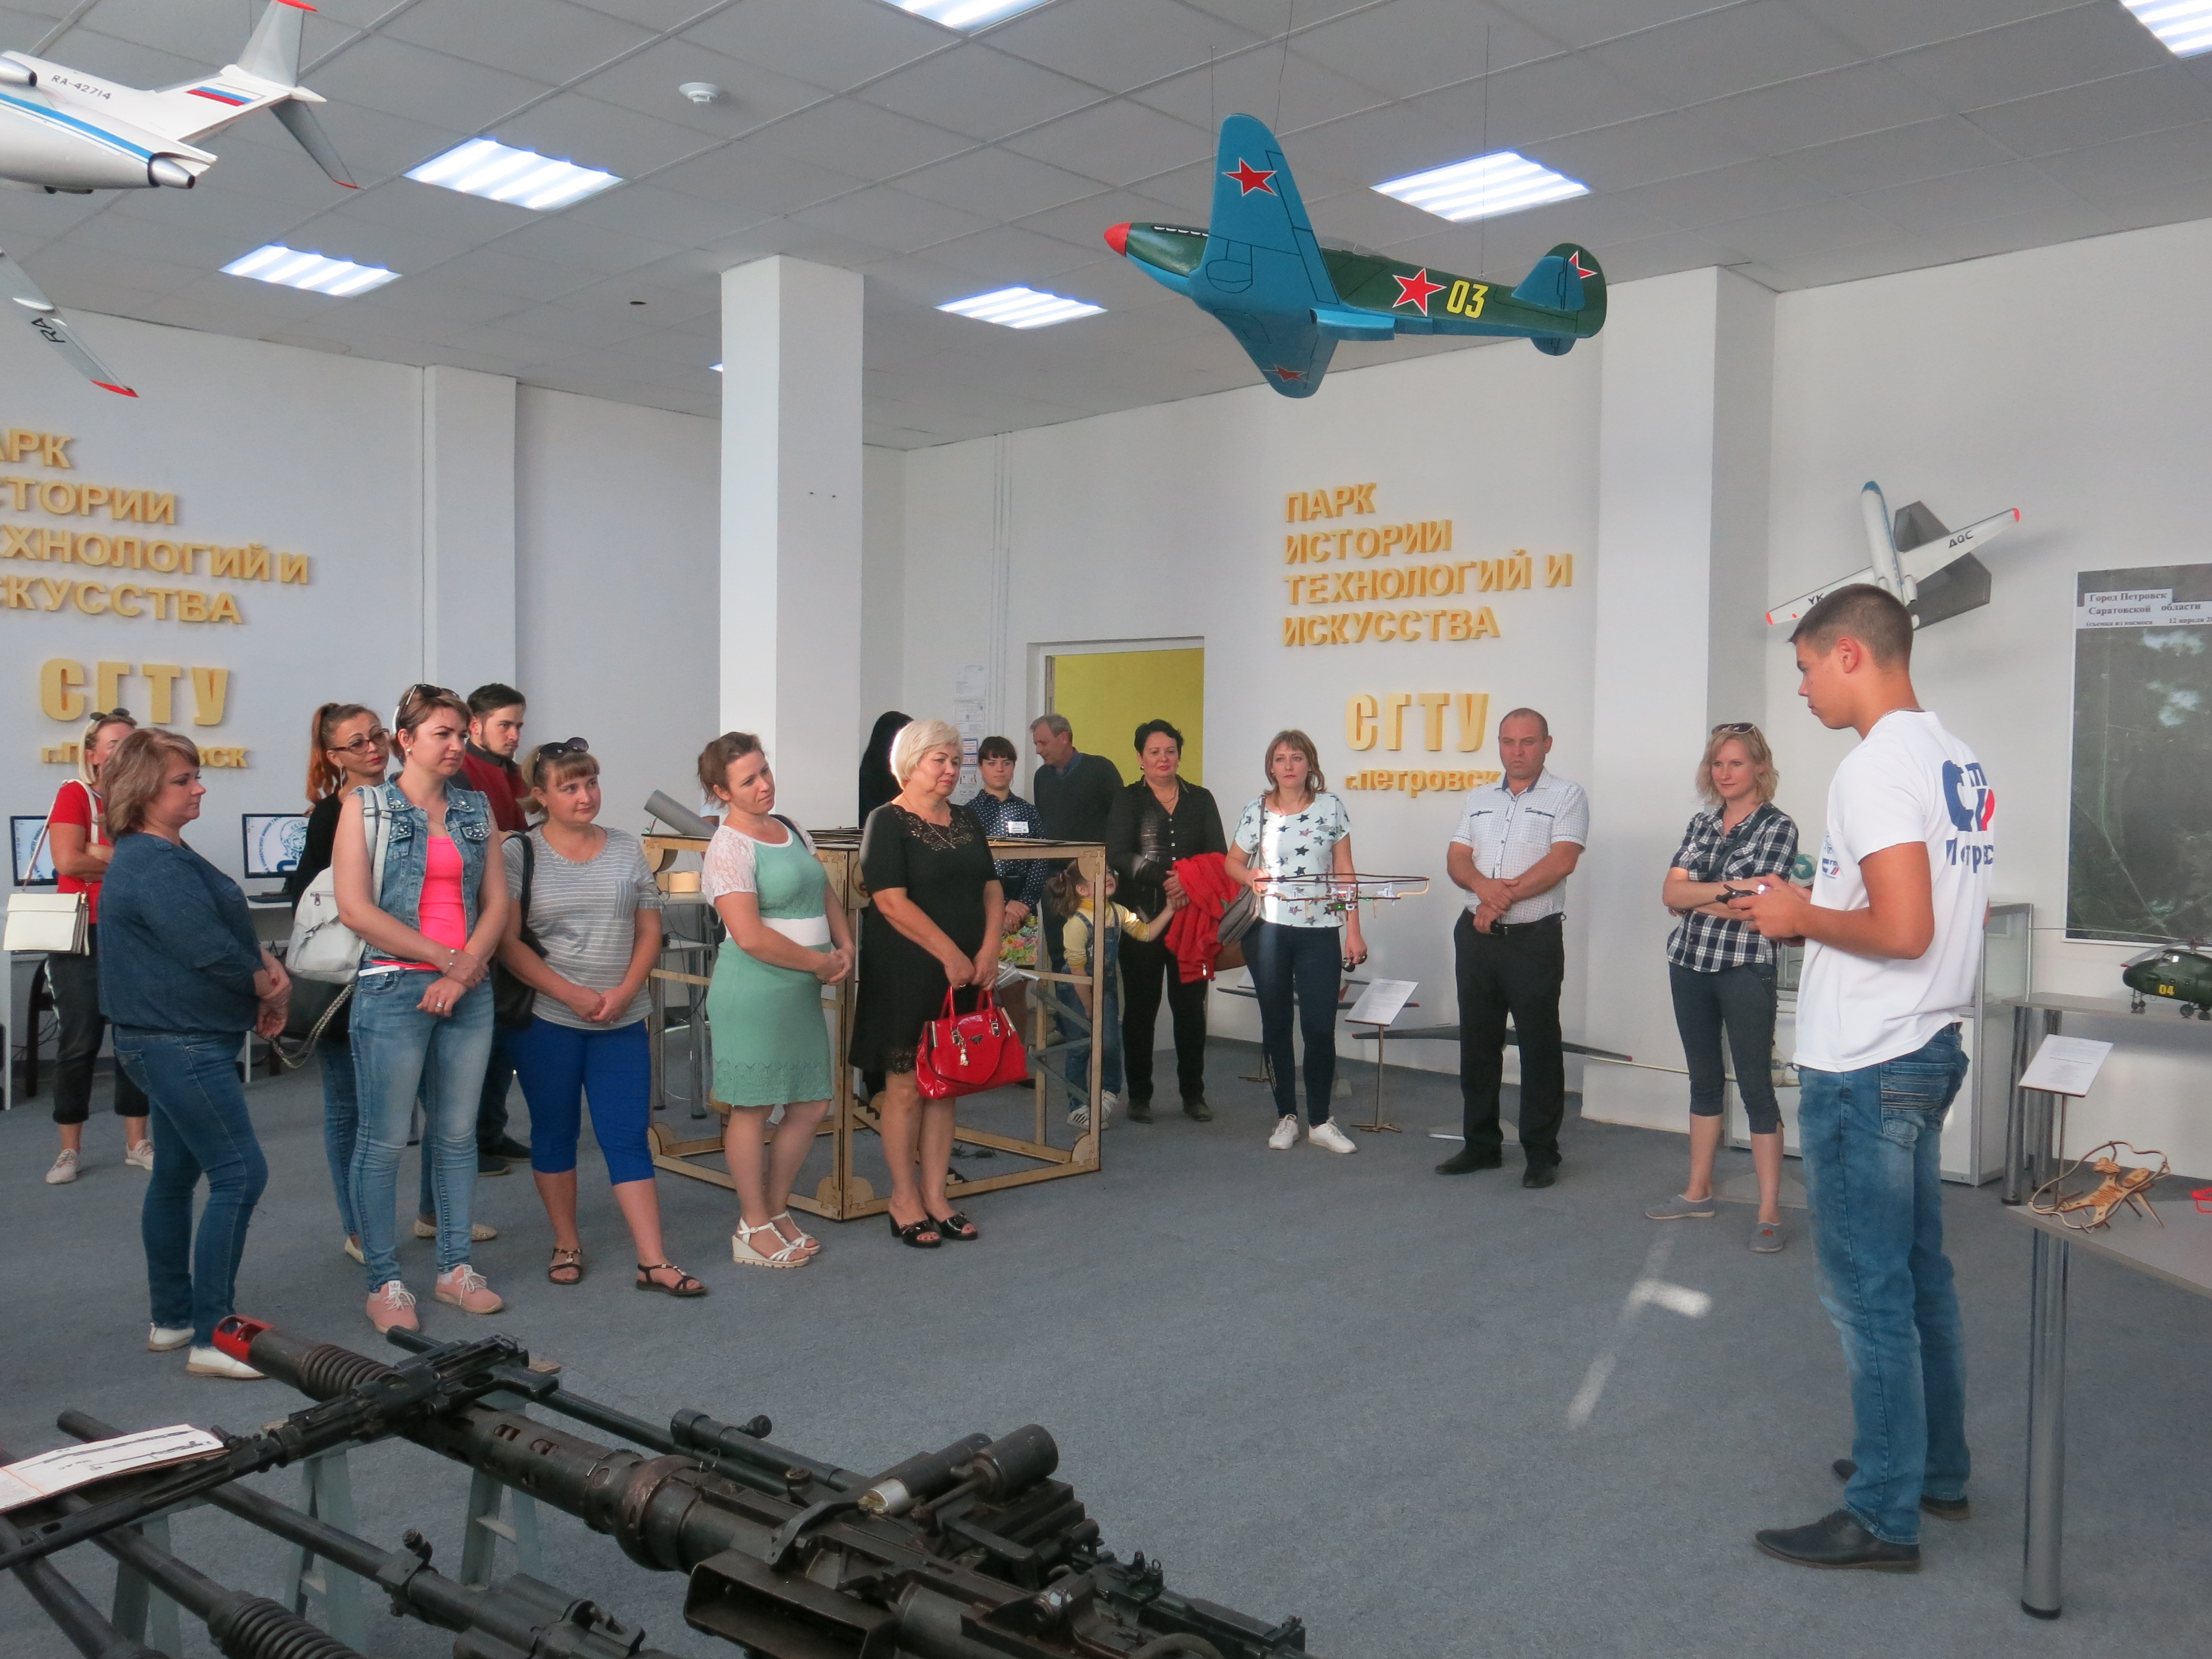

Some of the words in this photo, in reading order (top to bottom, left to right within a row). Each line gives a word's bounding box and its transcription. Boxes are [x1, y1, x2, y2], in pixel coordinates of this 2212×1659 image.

[51, 75, 112, 100] RA-42714
[1446, 280, 1489, 319] 03
[0, 429, 71, 469] РК
[0, 476, 175, 525] ТОРИИ
[1285, 482, 1377, 523] ПАРК
[0, 524, 270, 582] ХНОЛОГИЙ
[280, 554, 308, 584] И
[1284, 519, 1453, 564] ИСТОРИИ
[1284, 549, 1533, 605] ТЕХНОЛОГИЙ
[1545, 554, 1573, 588] И
[2089, 594, 2118, 603] Город
[2120, 592, 2168, 602] Петровск
[0, 575, 242, 624] КУССТВА
[2089, 606, 2152, 616] Саратовской
[2161, 603, 2201, 612] области
[1282, 606, 1500, 646] ИСКУССТВА
[39, 659, 228, 727] СГТУ
[1345, 692, 1489, 752] СГТУ
[2159, 984, 2174, 995] 04
